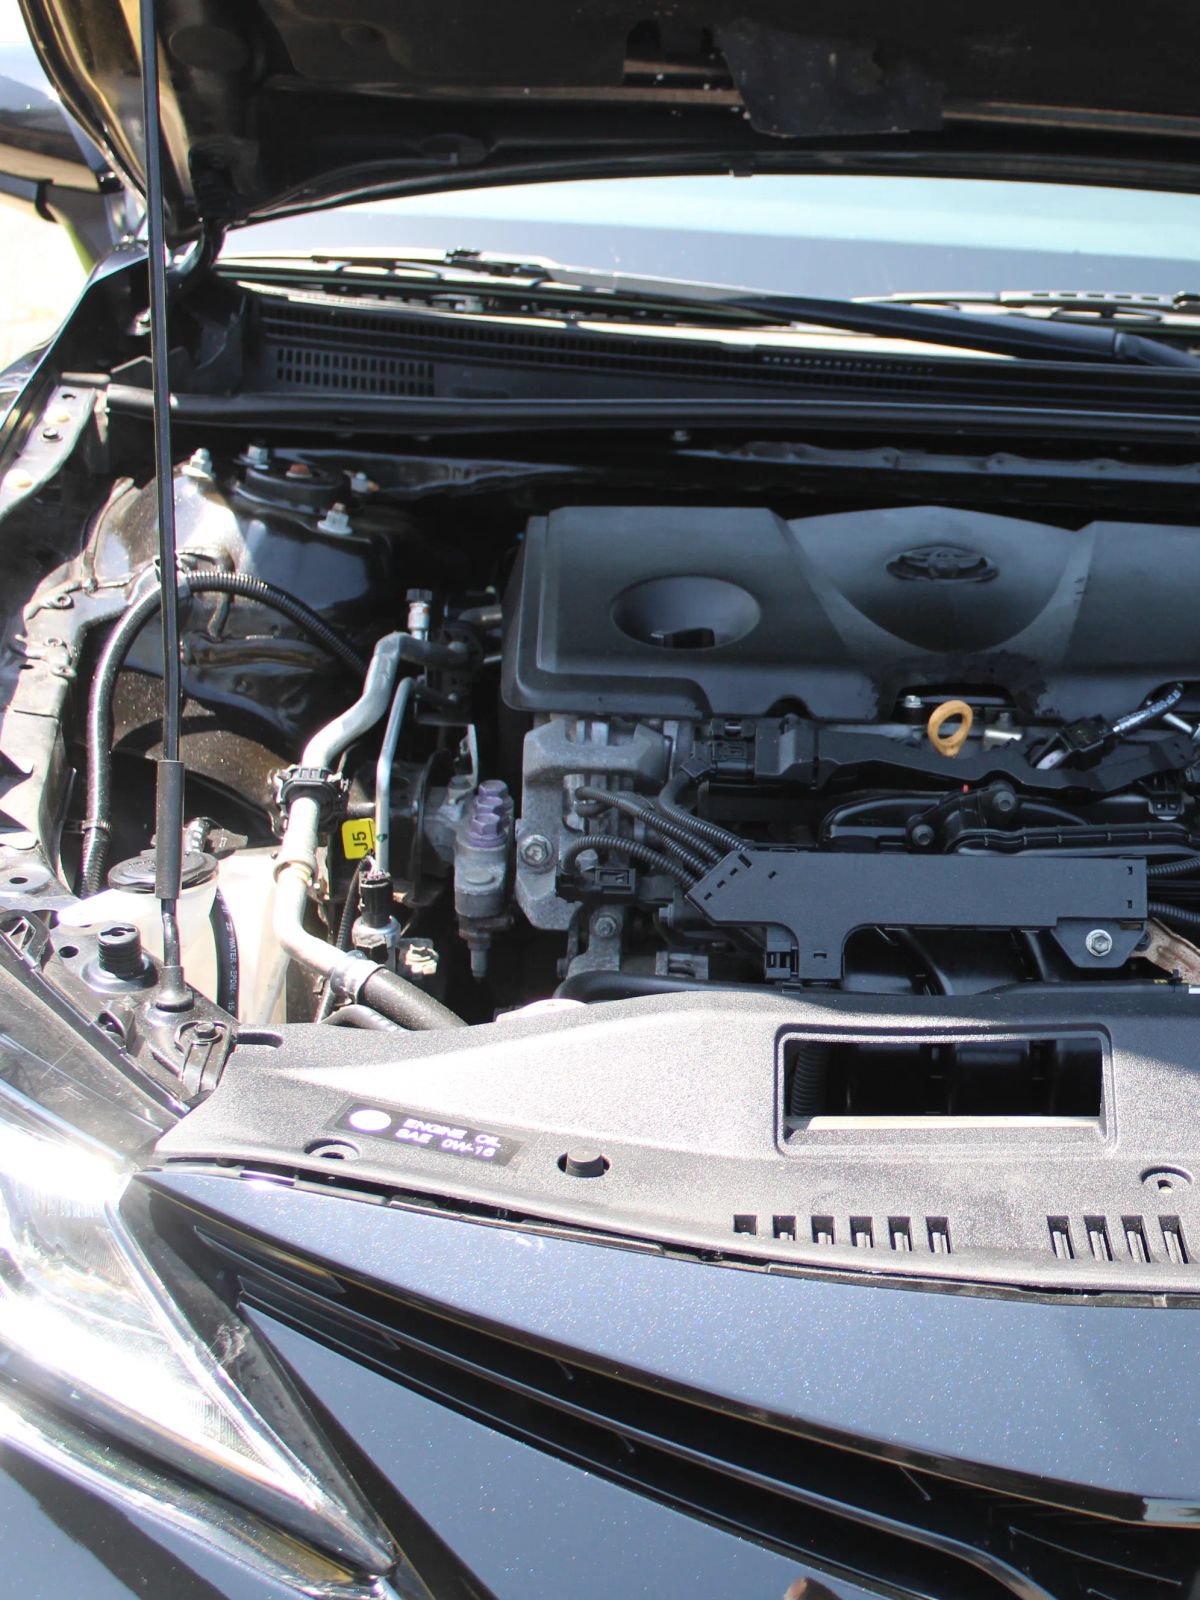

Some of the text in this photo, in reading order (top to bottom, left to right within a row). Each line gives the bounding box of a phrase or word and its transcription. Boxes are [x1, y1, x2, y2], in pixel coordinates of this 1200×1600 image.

[395, 1128, 433, 1144] SAE
[403, 1118, 502, 1148] ENGINE OIL
